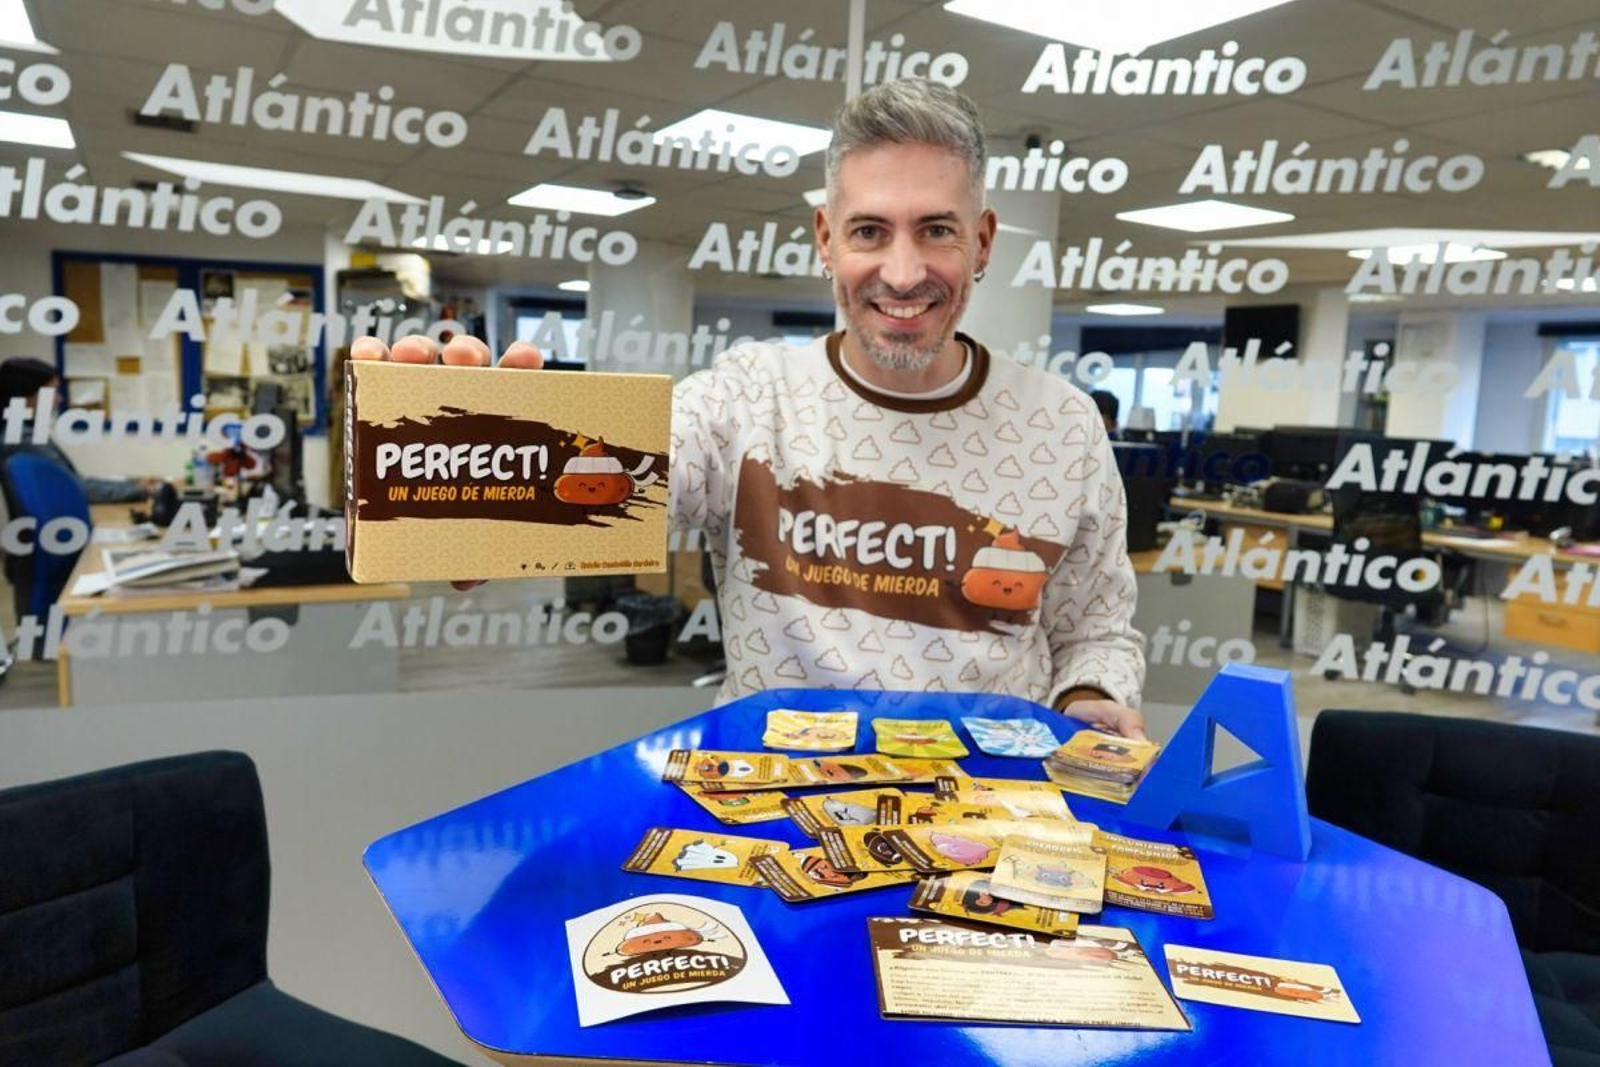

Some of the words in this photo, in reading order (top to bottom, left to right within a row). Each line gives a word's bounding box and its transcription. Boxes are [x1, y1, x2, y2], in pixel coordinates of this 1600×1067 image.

[695, 22, 968, 88] Atlántico
[1021, 41, 1307, 95] Atlántico
[140, 63, 468, 148] Atlántico
[523, 107, 799, 178] Atlántico
[1178, 139, 1484, 195] Atlántico
[0, 157, 282, 238] tlántico
[344, 195, 638, 266] Atlántico
[687, 221, 822, 277] Atlá
[1010, 237, 1290, 293] Atlántico
[1345, 240, 1600, 296] Atlánti
[375, 442, 549, 481] PERFECT!
[388, 486, 408, 501] UN
[412, 486, 457, 501] JUEGO
[461, 486, 480, 501] DE
[483, 486, 536, 501] MIERDA
[778, 507, 957, 572] PERFECT!
[1150, 527, 1442, 593] Atlántico
[803, 564, 851, 586] JUEGO
[851, 572, 870, 592] DE
[873, 574, 941, 598] MIERDA
[349, 598, 630, 650] Atlántico
[899, 928, 1035, 949] PERFECT!
[610, 955, 730, 985] PERFECT!
[622, 981, 637, 990] UN
[639, 974, 670, 986] JUEGO
[673, 972, 686, 980] DE
[688, 970, 726, 978] MIERDA
[1176, 963, 1271, 988] PERFECT!
